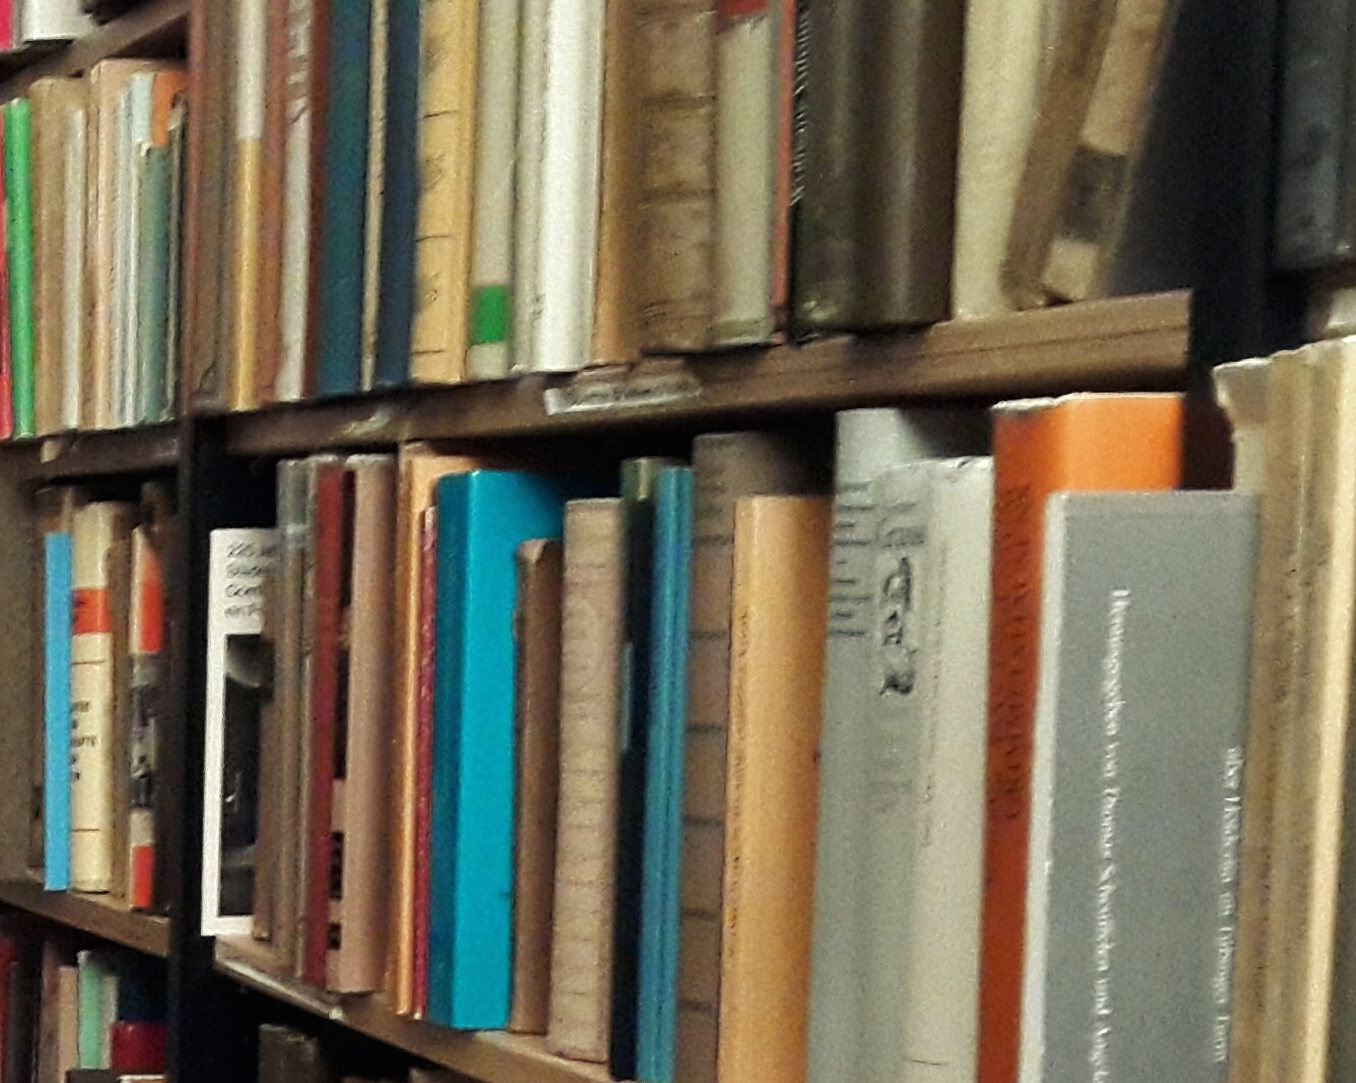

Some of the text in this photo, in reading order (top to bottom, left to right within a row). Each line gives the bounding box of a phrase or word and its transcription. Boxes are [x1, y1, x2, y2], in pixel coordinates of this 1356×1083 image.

[1100, 588, 1132, 737] Herausgegeben
[1102, 741, 1120, 779] von
[1099, 786, 1122, 860] Thomas
[1094, 978, 1112, 1015] und
[1212, 1014, 1232, 1063] Turm
